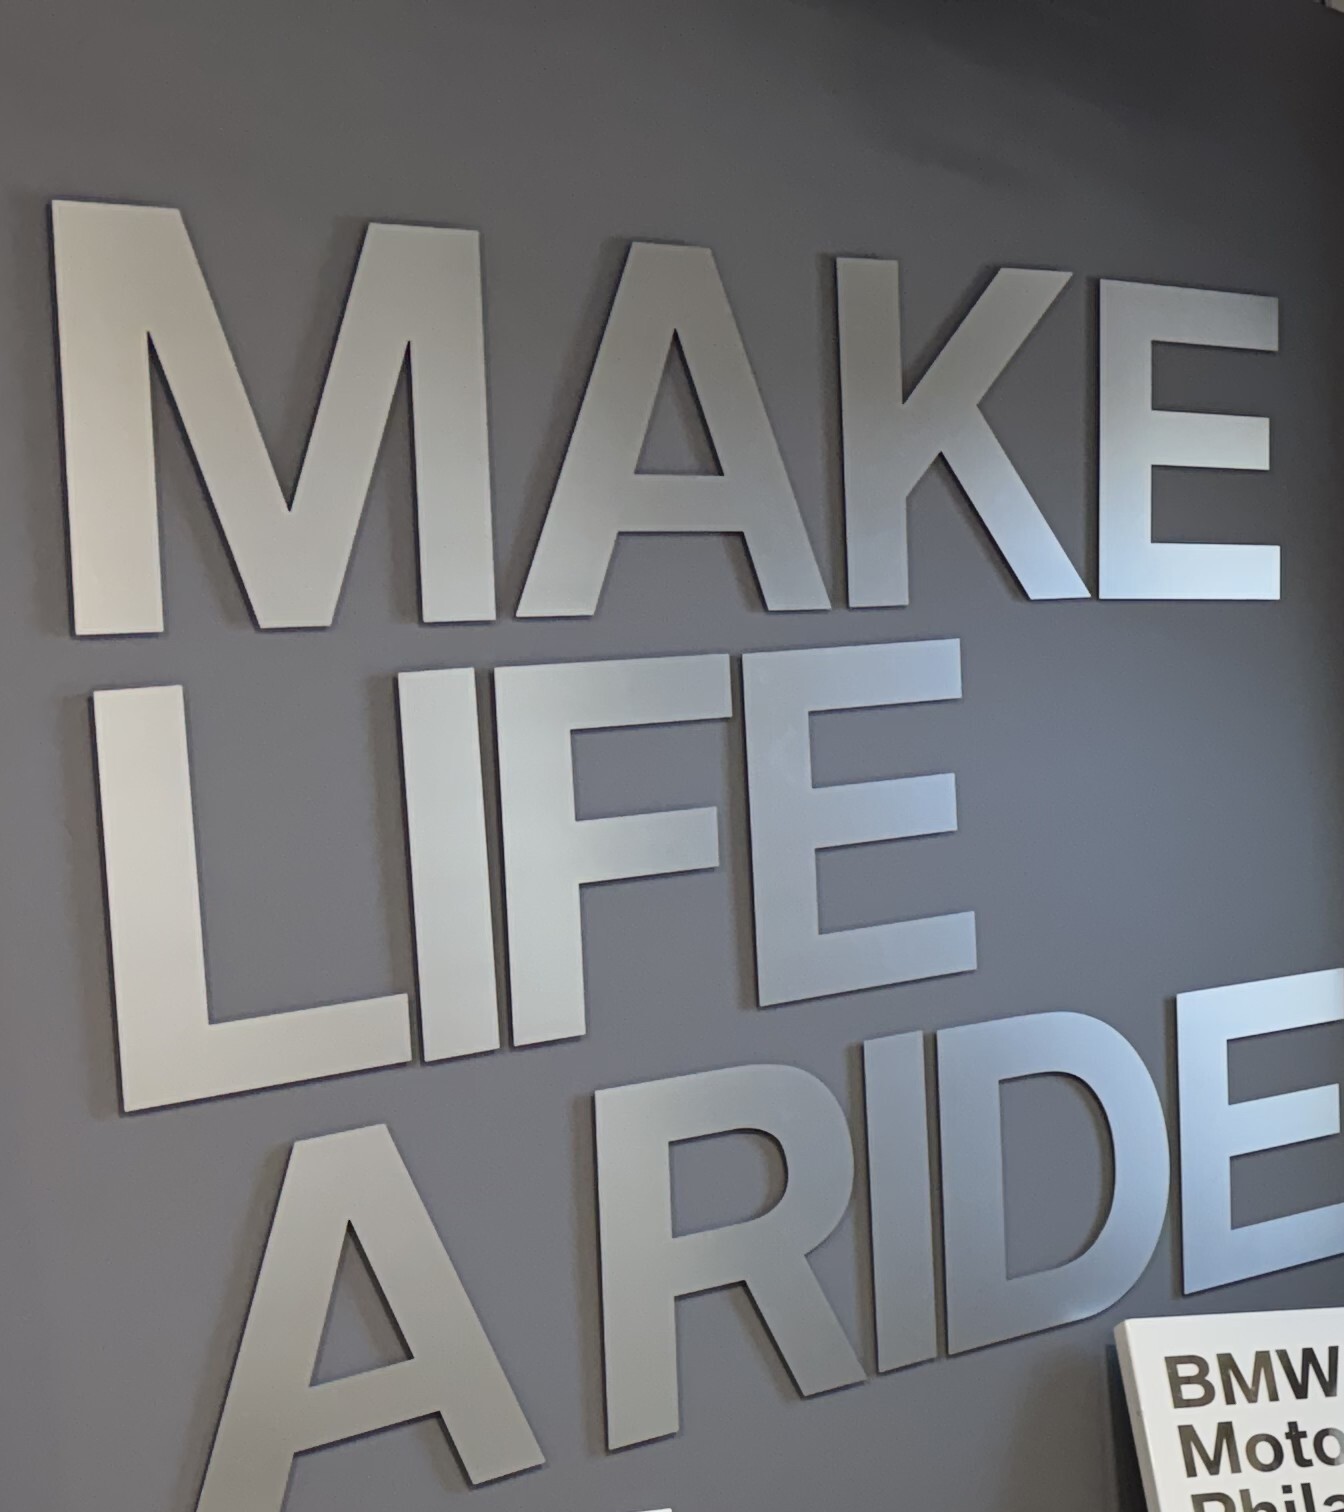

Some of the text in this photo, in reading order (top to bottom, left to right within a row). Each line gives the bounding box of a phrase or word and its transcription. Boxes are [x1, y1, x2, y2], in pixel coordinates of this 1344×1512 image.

[51, 199, 1281, 638] MAKE
[90, 638, 978, 1113] LIFE
[1163, 1345, 1340, 1409] BMW
